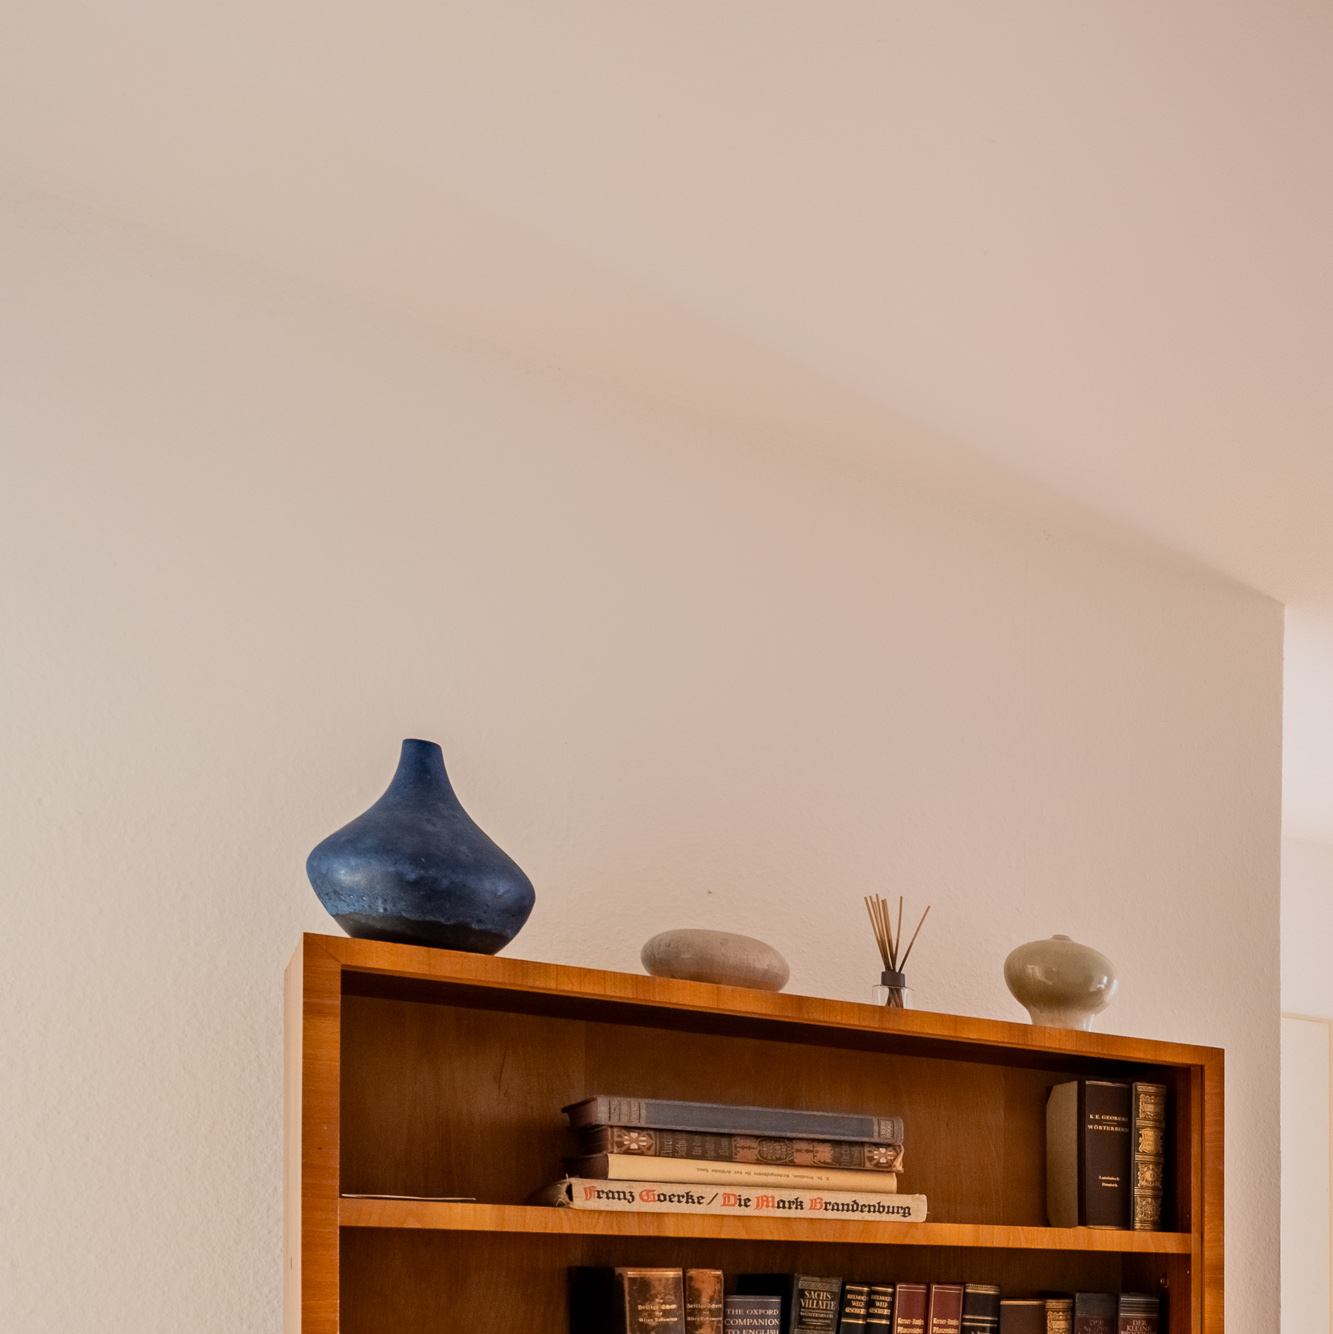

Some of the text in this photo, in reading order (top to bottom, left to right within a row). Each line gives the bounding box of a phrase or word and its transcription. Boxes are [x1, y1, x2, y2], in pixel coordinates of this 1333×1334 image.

[583, 1186, 635, 1203] Franz
[639, 1189, 705, 1206] Goerke
[720, 1194, 751, 1208] Die
[754, 1194, 804, 1210] Mark
[808, 1198, 912, 1218] Brandenburg
